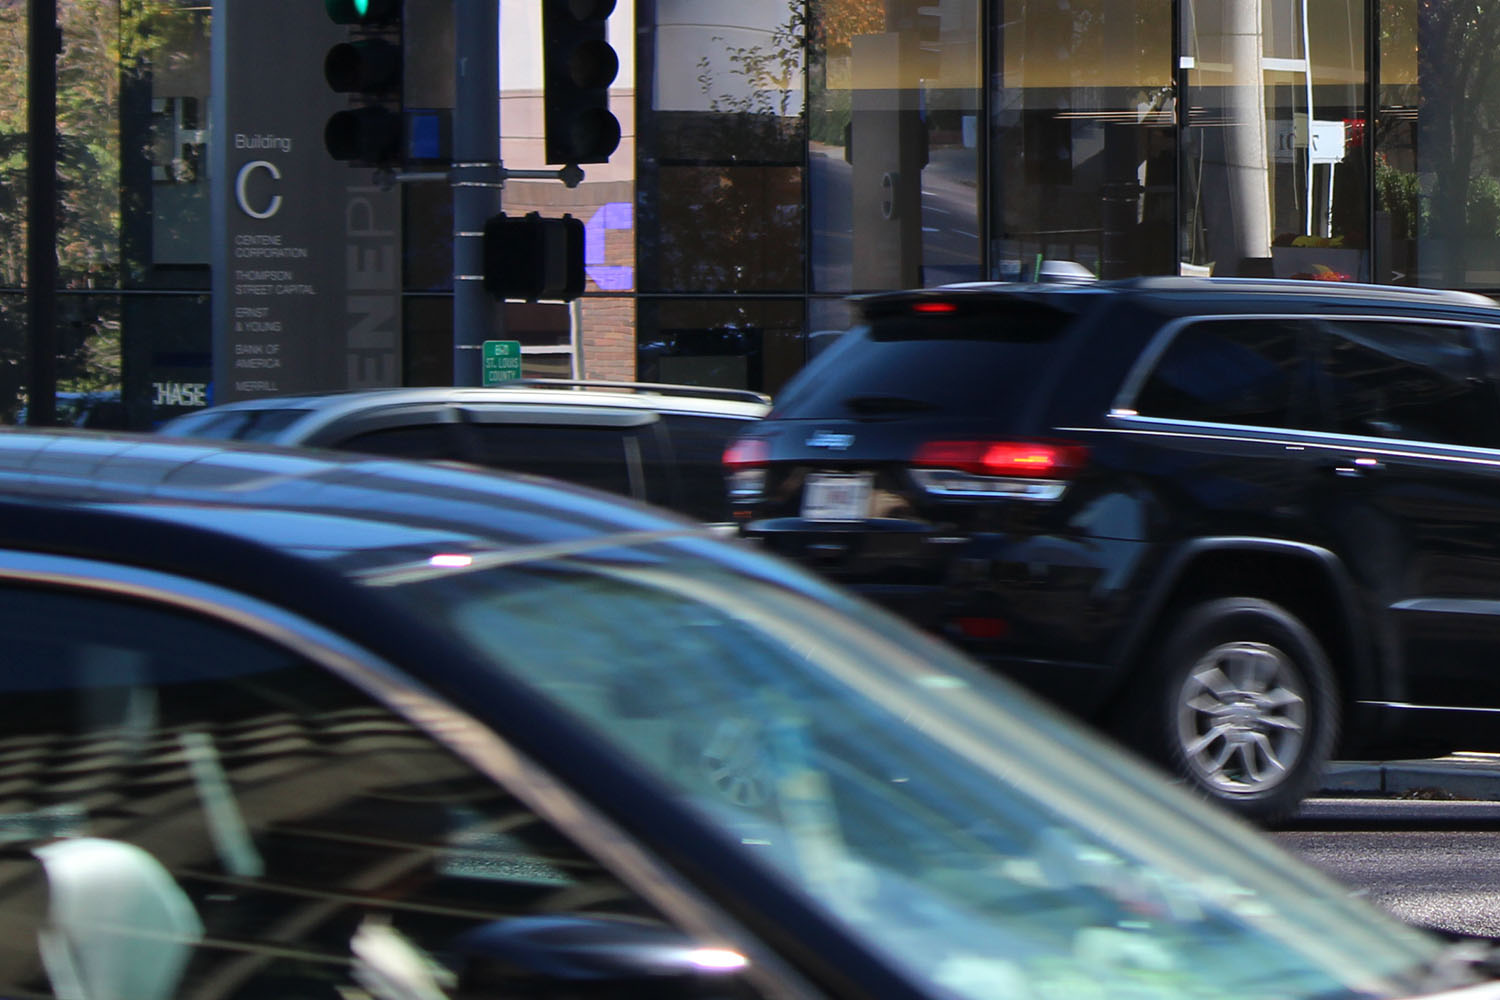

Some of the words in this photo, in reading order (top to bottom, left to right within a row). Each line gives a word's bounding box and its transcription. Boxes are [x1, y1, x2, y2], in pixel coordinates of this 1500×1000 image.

[235, 133, 291, 153] Building
[235, 160, 283, 219] C
[235, 247, 308, 258] CORPORATION
[235, 270, 292, 281] THOMPSON
[235, 284, 273, 295] STREET
[275, 284, 317, 295] CAPITAL
[235, 344, 263, 355] BANK
[265, 344, 280, 355] OF
[498, 357, 519, 369] LOUIS
